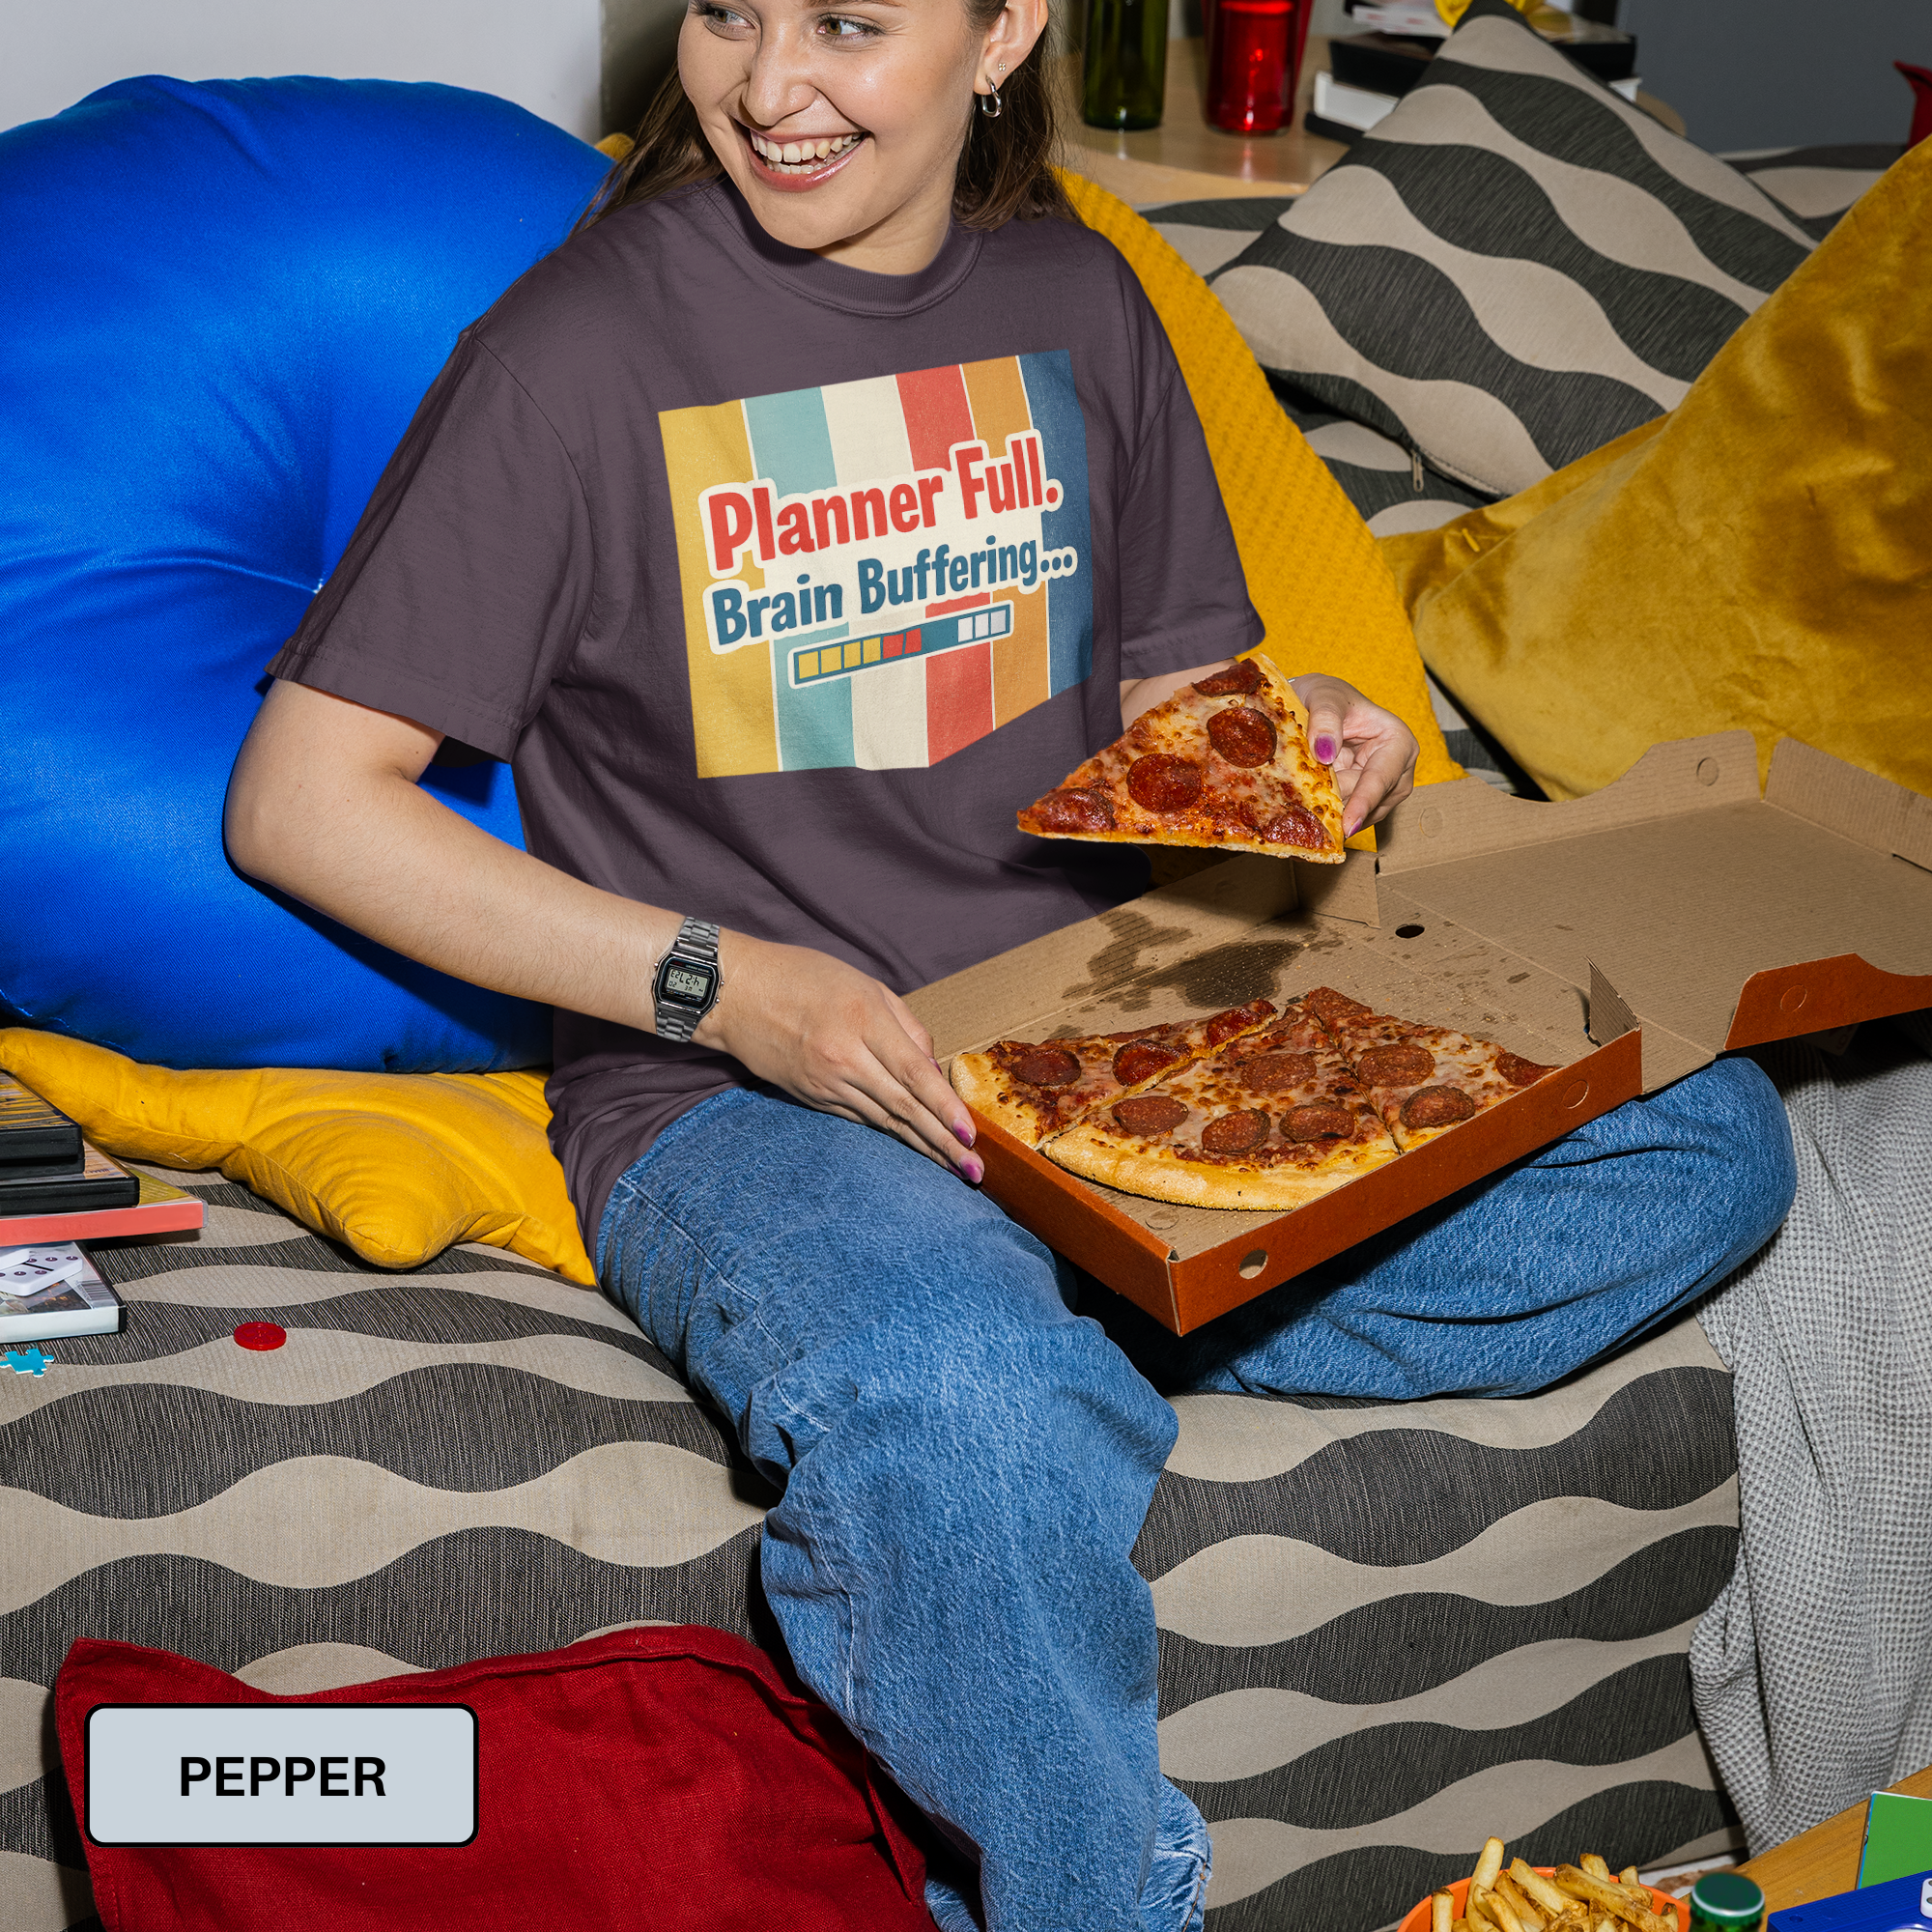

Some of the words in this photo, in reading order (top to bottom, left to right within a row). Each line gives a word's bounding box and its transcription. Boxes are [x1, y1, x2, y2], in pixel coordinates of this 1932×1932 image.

[708, 475, 944, 571] Planner
[955, 437, 1059, 520] Full.
[712, 574, 843, 646] Brain
[858, 535, 1073, 614] Buffering...
